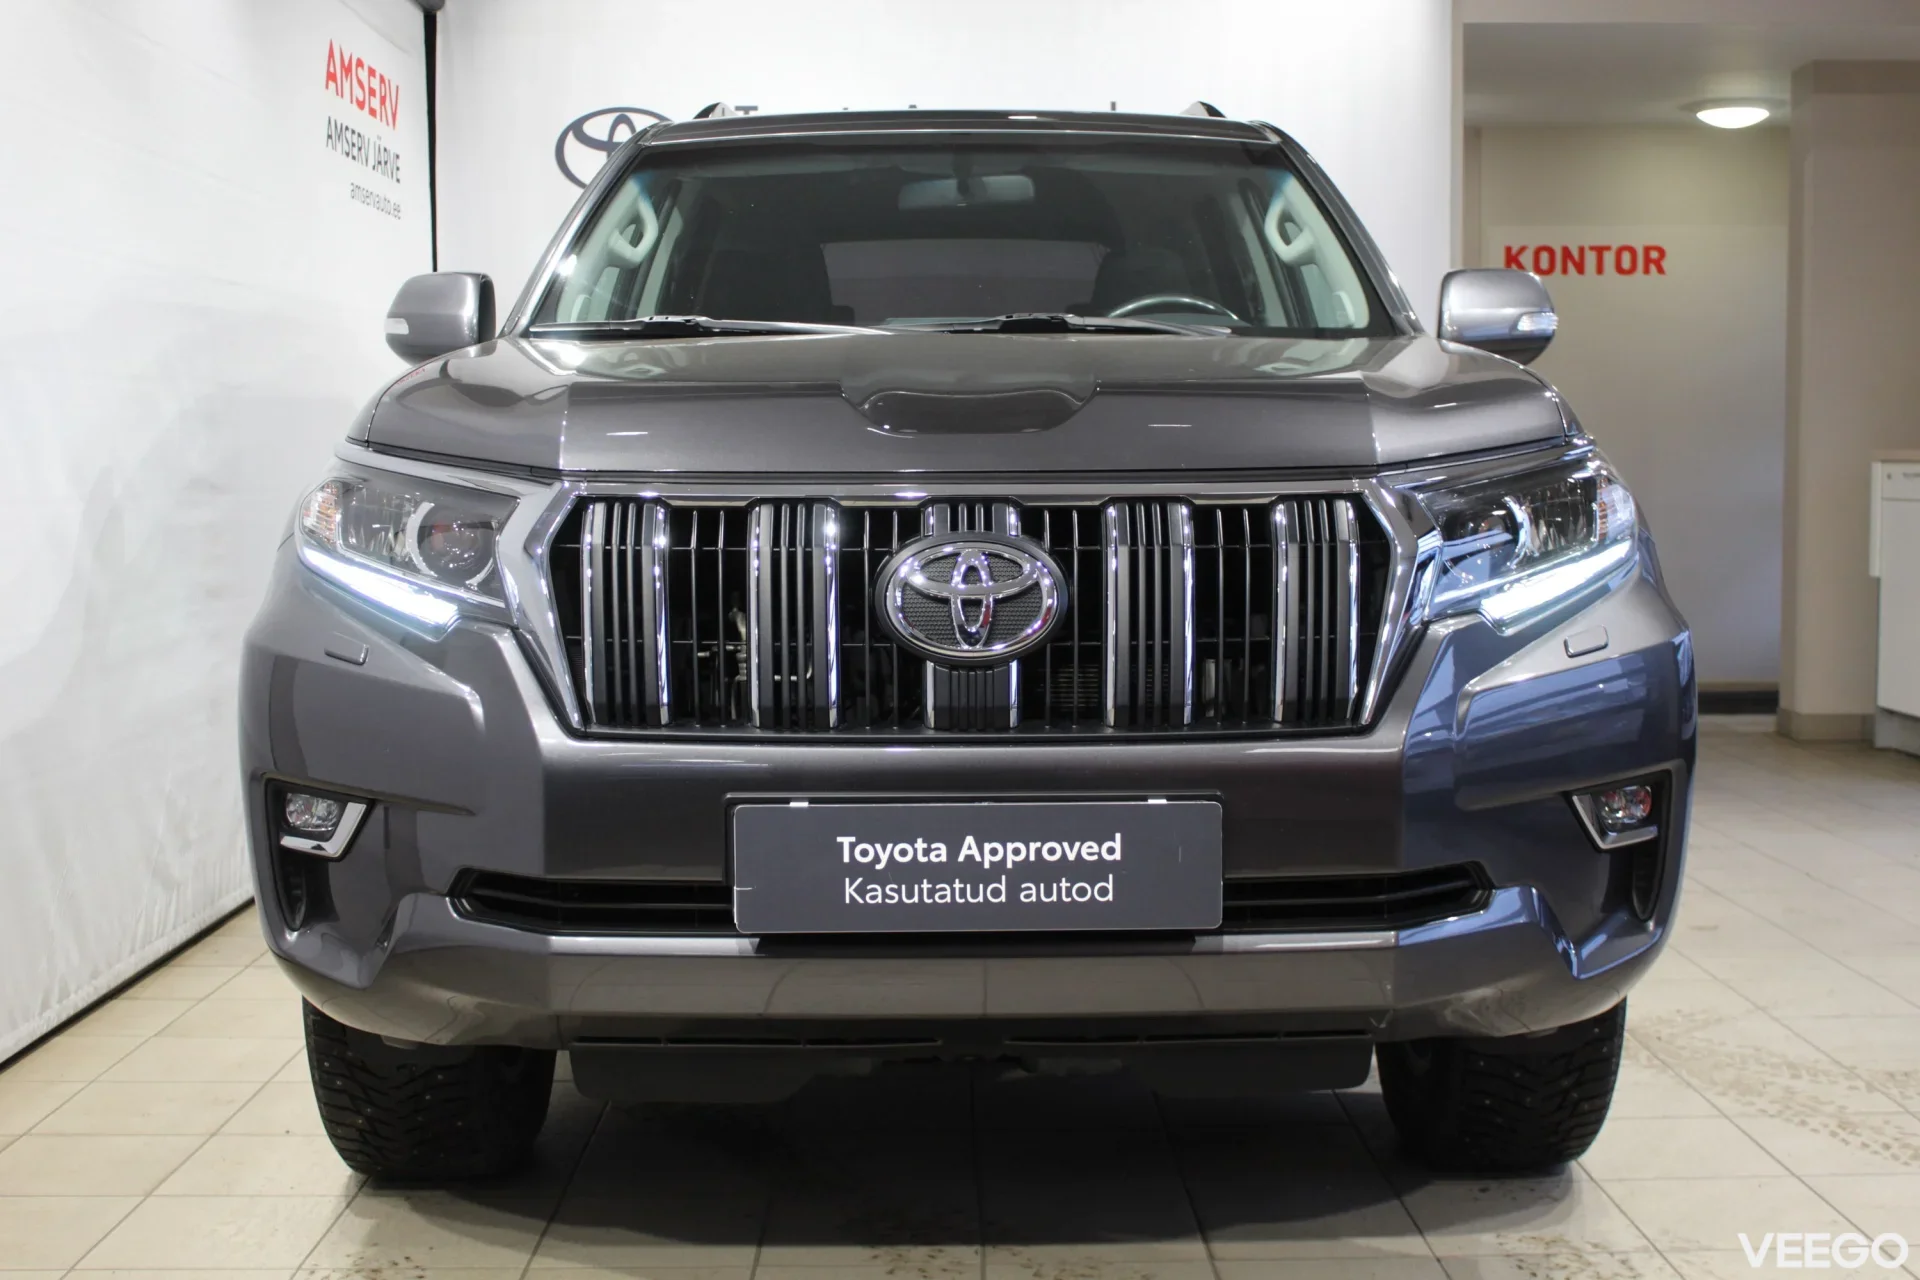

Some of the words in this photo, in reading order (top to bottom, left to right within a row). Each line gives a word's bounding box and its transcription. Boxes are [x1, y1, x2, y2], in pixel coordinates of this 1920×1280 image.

[326, 39, 399, 130] AMSERV
[326, 116, 370, 167] AMSERV
[372, 135, 400, 183] JÄRVE
[350, 183, 401, 219] amservauto.ee
[1504, 244, 1667, 276] KONTOR
[837, 836, 947, 869] Toyota
[958, 833, 1122, 868] Approved
[844, 875, 1006, 904] Kasutatud
[1019, 874, 1114, 902] autod
